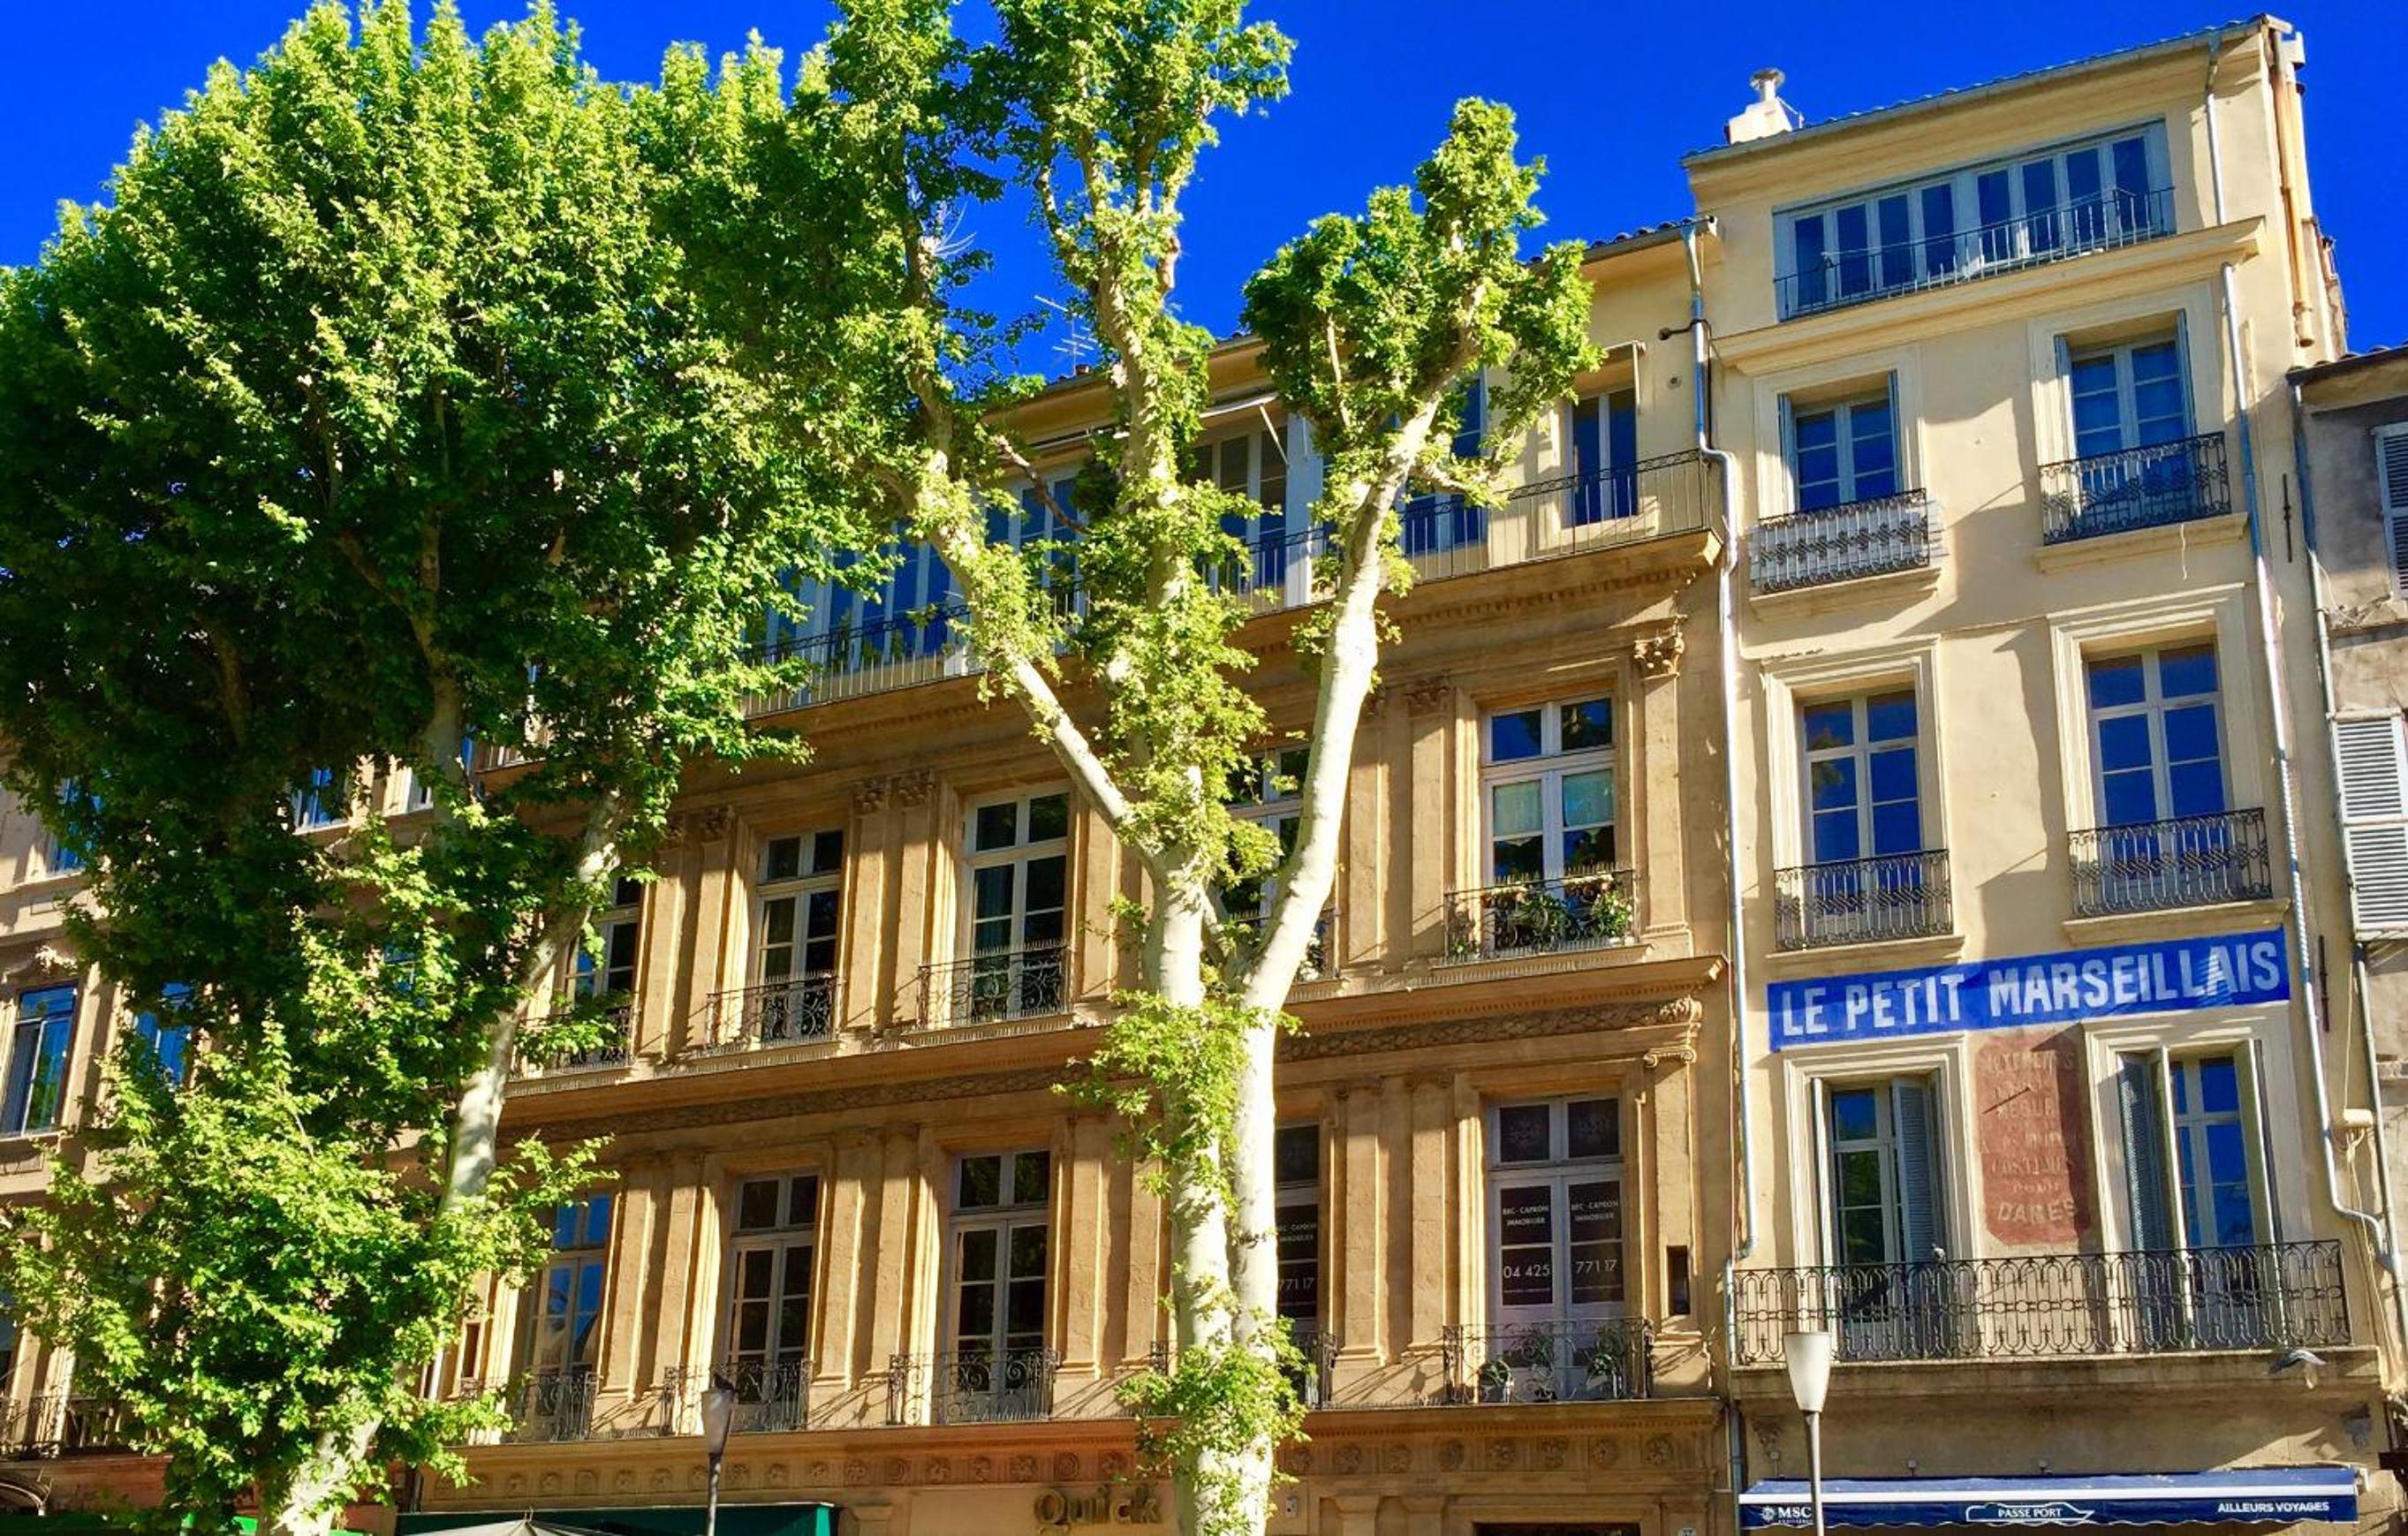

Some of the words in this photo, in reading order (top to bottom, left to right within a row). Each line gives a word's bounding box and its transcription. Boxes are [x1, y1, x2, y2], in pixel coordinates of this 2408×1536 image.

[1782, 986, 1828, 1037] LE
[1845, 973, 1965, 1031] PETIT
[1988, 941, 2281, 1017] MARSEILLAIS
[1503, 1266, 1521, 1279] 04
[1525, 1264, 1550, 1277] 425
[1576, 1260, 1601, 1274] 771
[1034, 1485, 1162, 1533] Quick
[1777, 1506, 1812, 1518] MSC
[1997, 1508, 2032, 1518] PASSE
[2033, 1508, 2063, 1518] PORT
[2218, 1502, 2274, 1513] AILLEURS
[2275, 1501, 2330, 1512] VOYAGES
